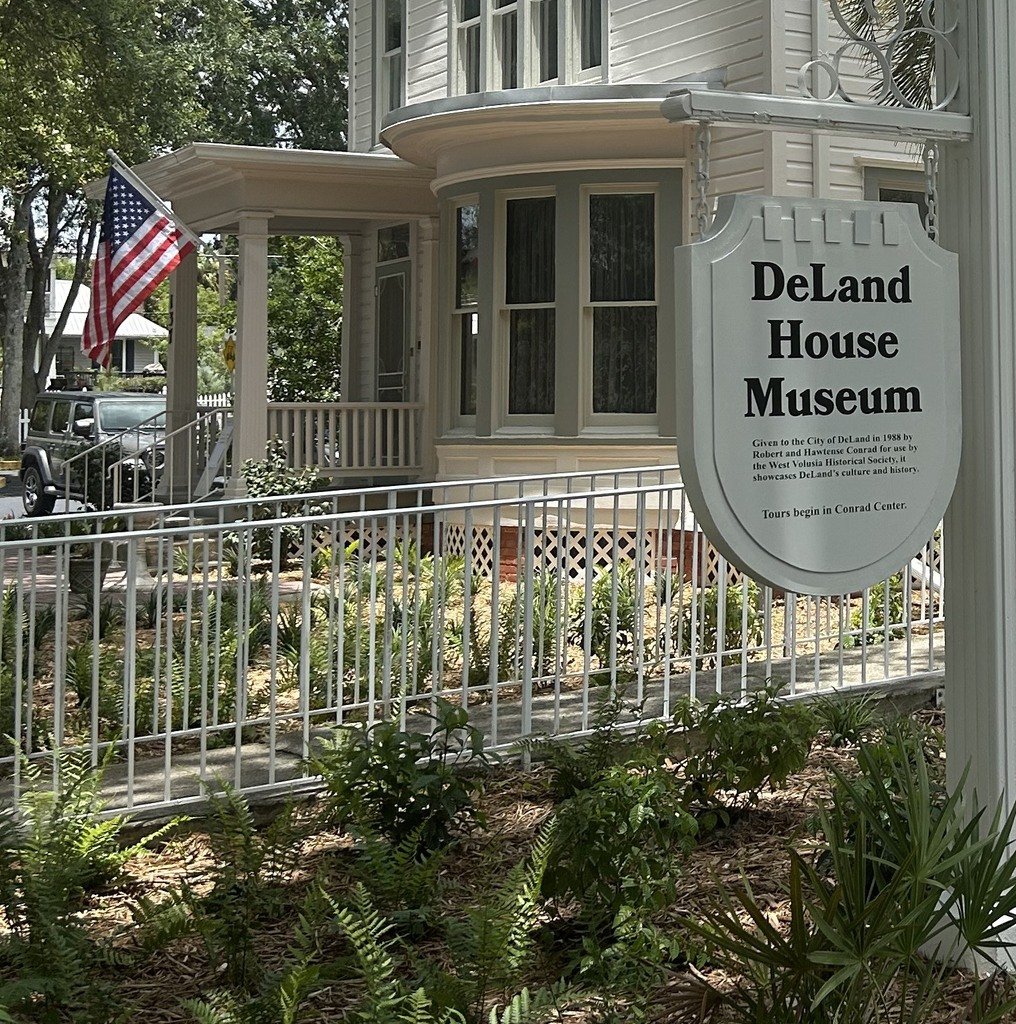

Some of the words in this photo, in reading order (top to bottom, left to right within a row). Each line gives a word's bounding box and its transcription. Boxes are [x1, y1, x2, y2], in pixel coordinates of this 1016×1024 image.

[751, 261, 912, 303] DeLand
[768, 319, 899, 359] House
[744, 377, 923, 418] Museum
[752, 439, 778, 447] Given
[792, 438, 805, 446] the
[807, 437, 824, 446] City
[828, 436, 836, 444] of
[838, 434, 870, 444] DeLand
[873, 434, 880, 442] in
[883, 434, 901, 442] 1988
[903, 433, 913, 442] by
[753, 450, 783, 458] Robert
[786, 449, 801, 457] and
[847, 446, 877, 454] Conrad
[880, 445, 891, 453] for
[909, 444, 918, 453] by
[769, 461, 790, 469] West
[793, 459, 822, 468] Volusia
[826, 457, 865, 466] Historical
[868, 456, 898, 465] Society,
[753, 473, 796, 482] showcases
[800, 470, 839, 479] DeLand's
[842, 468, 870, 477] culture
[890, 465, 919, 474] history.
[762, 509, 790, 519] Tours
[794, 507, 819, 519] begin
[823, 506, 831, 515] in
[835, 503, 870, 514] Conrad
[874, 502, 907, 511] Center.
